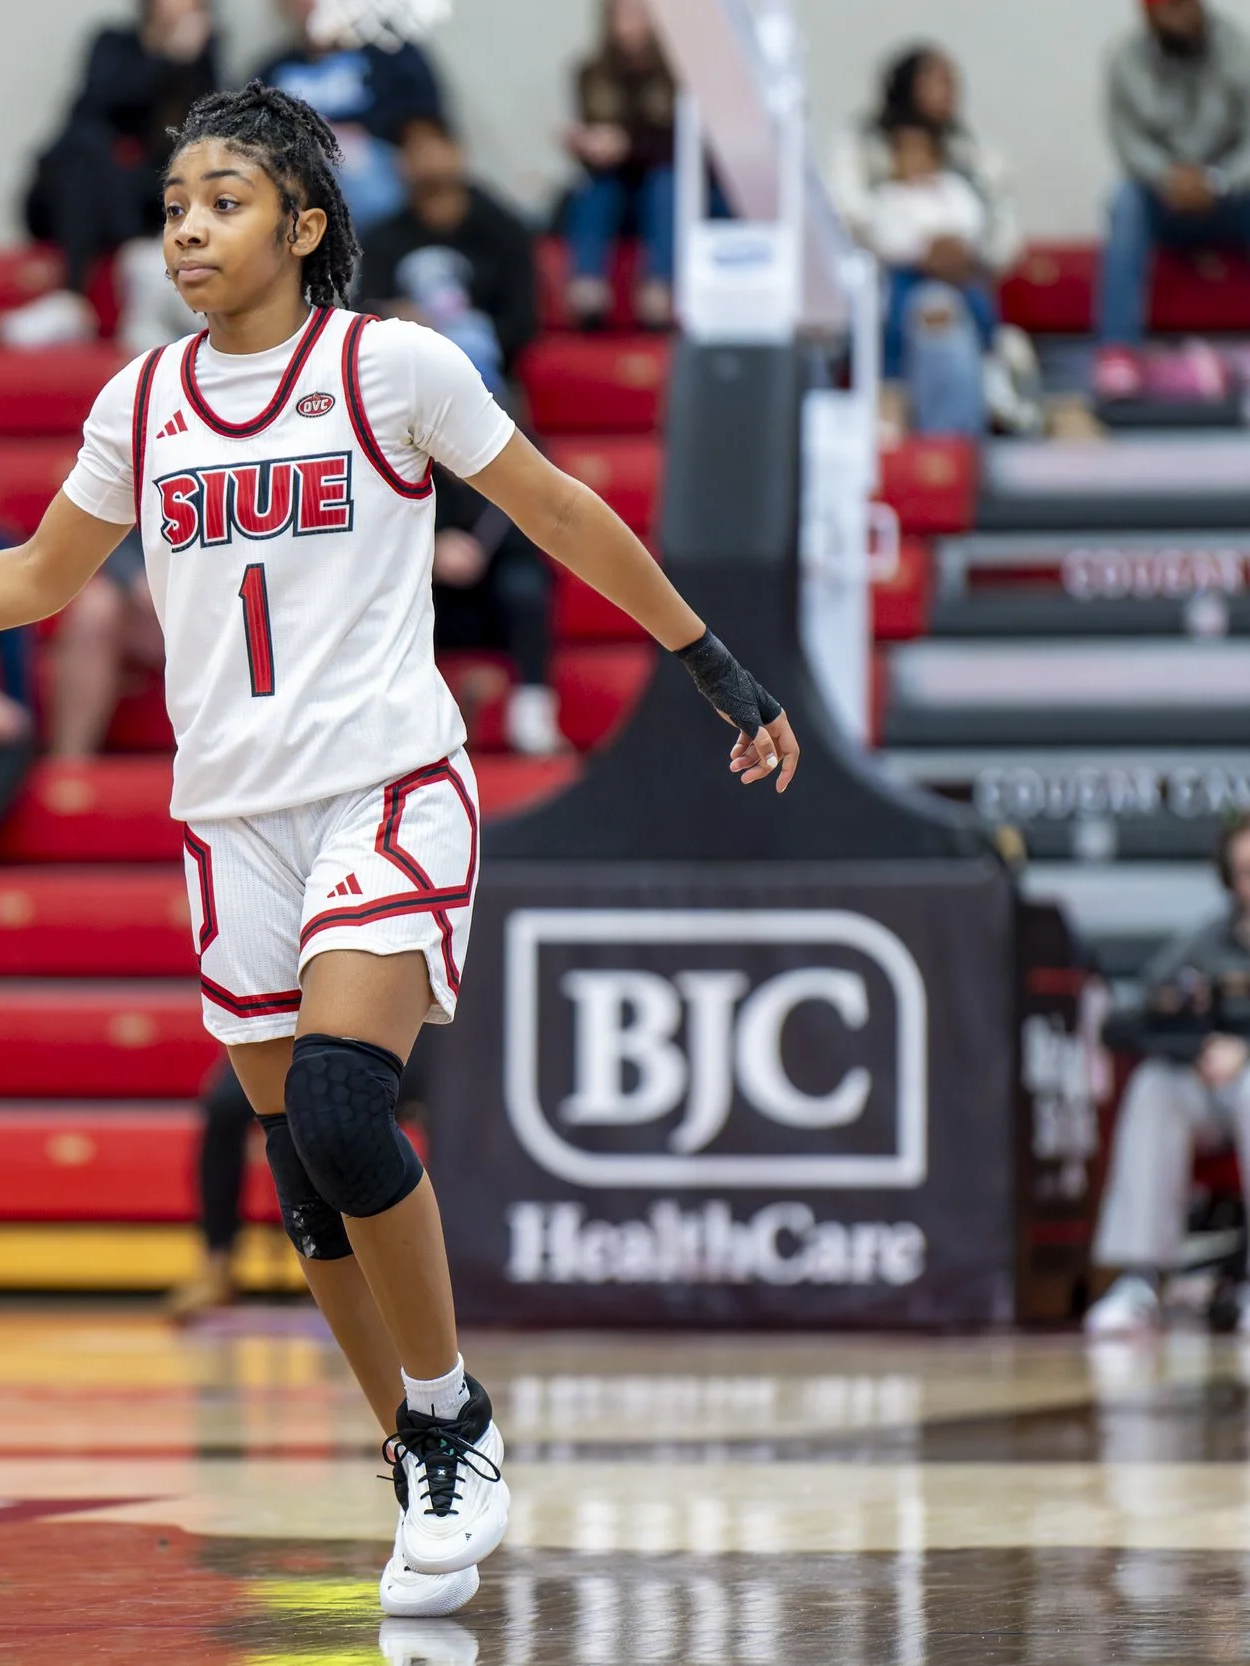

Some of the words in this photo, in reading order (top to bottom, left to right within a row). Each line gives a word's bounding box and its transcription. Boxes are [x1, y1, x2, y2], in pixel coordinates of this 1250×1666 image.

[303, 398, 329, 413] OVC
[152, 450, 354, 553] SIUE
[238, 562, 275, 697] 1
[561, 967, 872, 1154] BJC
[505, 1202, 927, 1286] HealthCare
